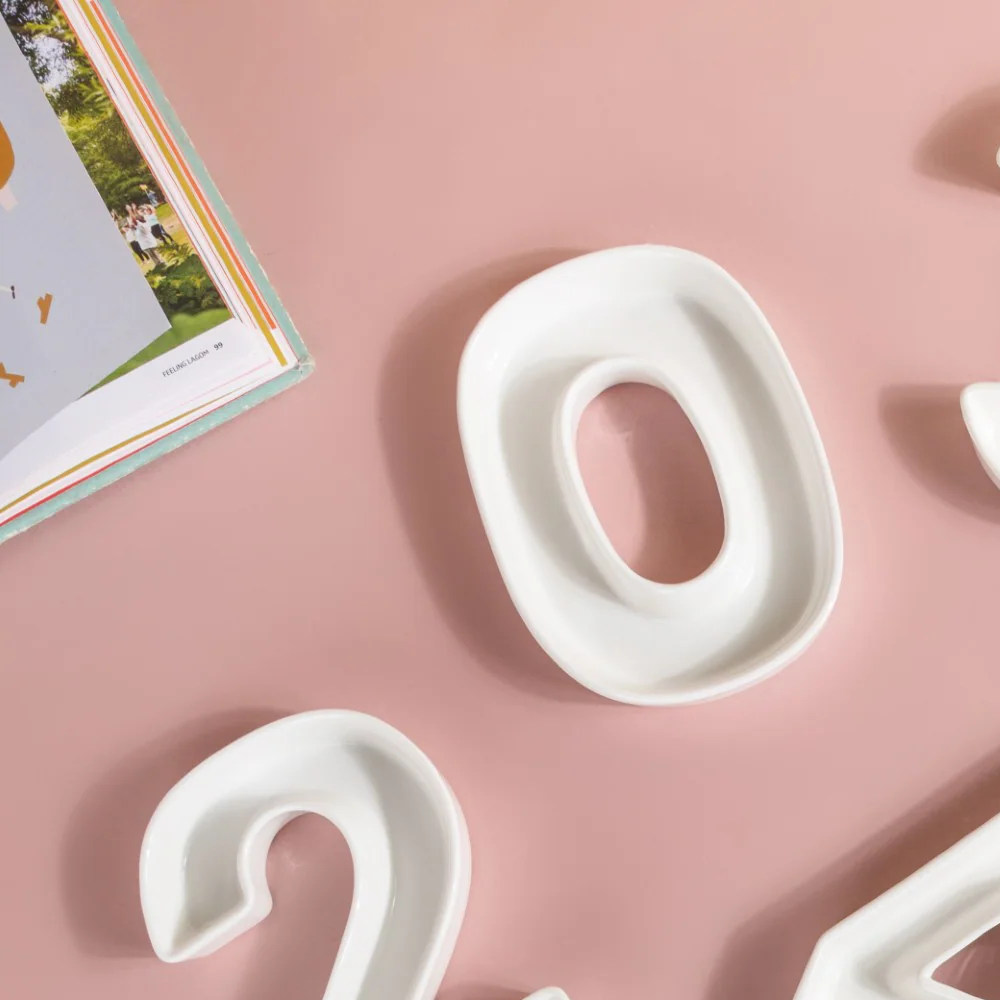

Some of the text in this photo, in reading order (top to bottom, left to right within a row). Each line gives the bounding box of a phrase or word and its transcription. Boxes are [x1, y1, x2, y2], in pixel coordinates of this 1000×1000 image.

[162, 341, 224, 377] FEELING LAGOM 99
[457, 244, 844, 706] 0
